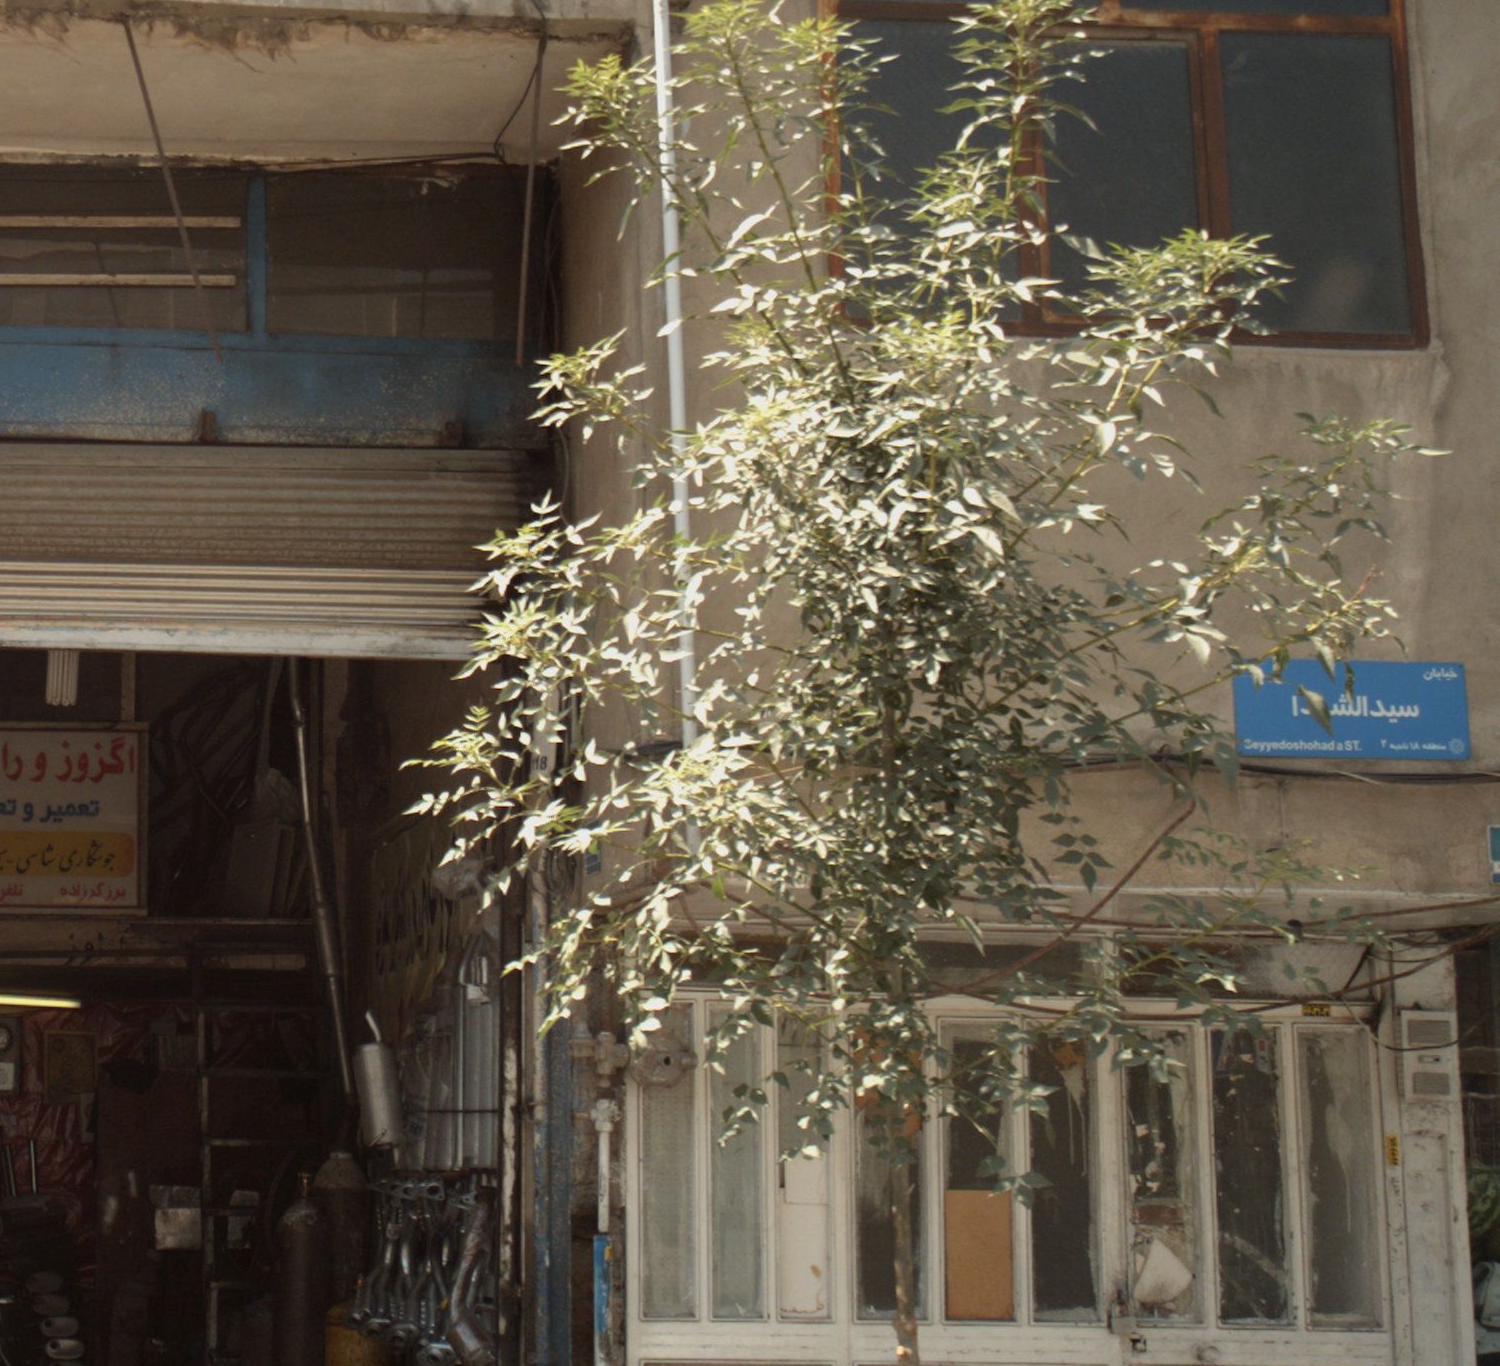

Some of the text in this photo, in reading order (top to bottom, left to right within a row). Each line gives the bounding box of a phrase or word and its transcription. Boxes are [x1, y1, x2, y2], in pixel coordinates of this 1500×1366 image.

[1423, 666, 1458, 681] خیابان
[1292, 693, 1420, 723] سیدالشا
[30, 752, 48, 783] و
[56, 736, 136, 784] اگزوز
[22, 802, 35, 823] و
[39, 799, 100, 824] تعمیر
